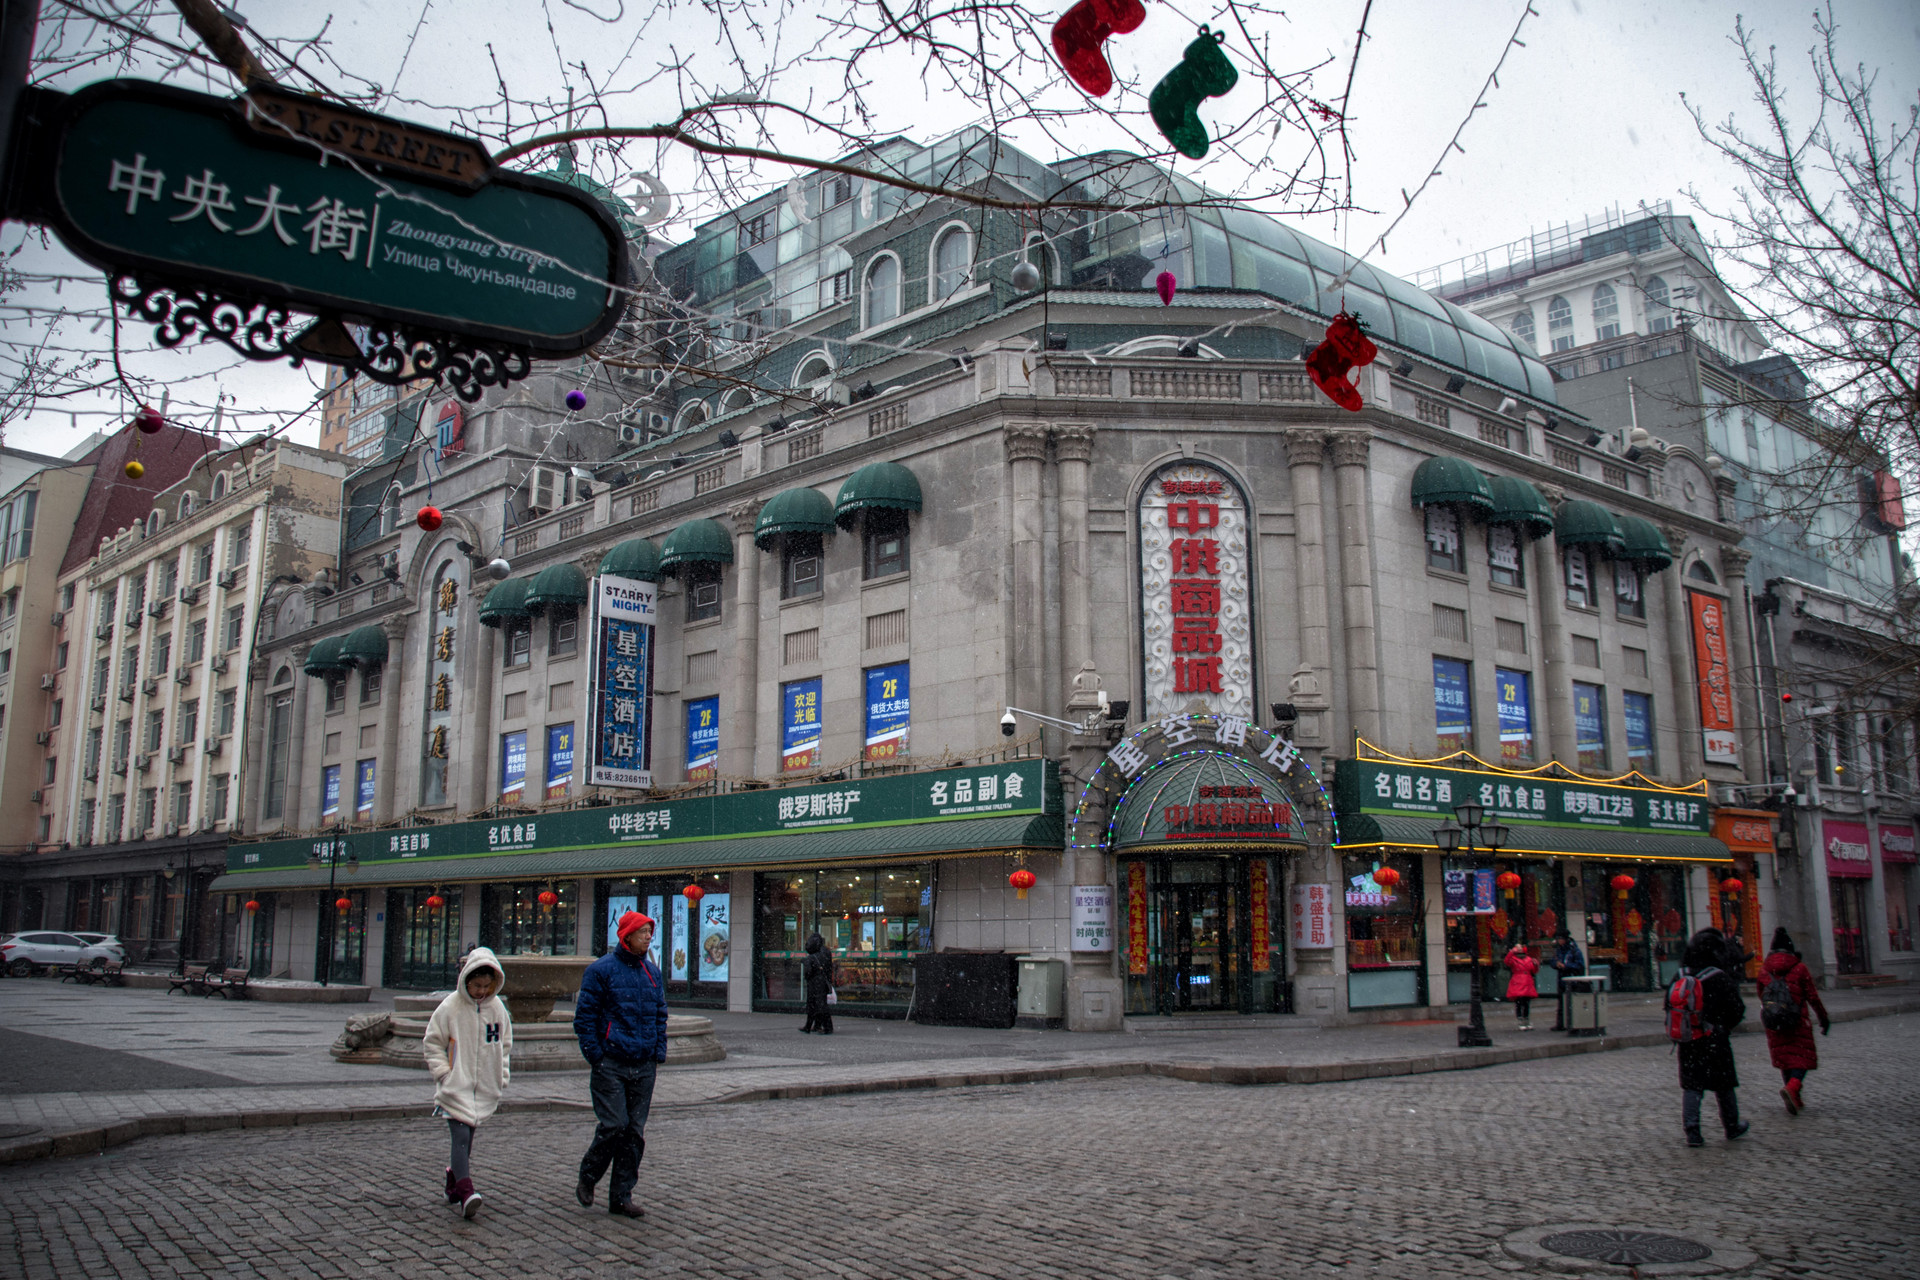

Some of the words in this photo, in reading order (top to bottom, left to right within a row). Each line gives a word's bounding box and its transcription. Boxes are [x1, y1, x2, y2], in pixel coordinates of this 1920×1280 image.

[107, 152, 368, 261] 中央大街
[387, 219, 494, 257] Zhongyang
[496, 244, 557, 270] Street
[384, 243, 440, 273] Улица
[446, 256, 576, 299] Чжунъяндацзе
[606, 586, 652, 603] STARRY
[1167, 499, 1224, 694] 中俄商品城
[612, 598, 648, 614] NIGHT
[612, 630, 638, 758] 星空酒店
[883, 679, 897, 699] 2F
[1434, 687, 1464, 706] 聚划算
[1504, 683, 1516, 702] 2F
[794, 691, 816, 708] 欢迎
[871, 698, 909, 715] 俄货大卖场
[1579, 697, 1589, 714] 2F
[700, 709, 712, 727] 2F
[794, 707, 816, 724] 光临
[559, 734, 569, 750] 2F
[692, 727, 719, 741] 俄罗斯食品
[1107, 712, 1300, 778] 星空酒店
[596, 771, 648, 784] 电话:82366111
[1375, 772, 1452, 803] 名烟名酒
[930, 772, 1024, 806] 名品副食
[1479, 782, 1546, 810] 名优食品
[778, 790, 860, 820] 俄罗斯特产
[1563, 790, 1634, 818] 俄罗斯工艺品
[1648, 798, 1700, 822] 东北特产
[608, 809, 671, 834] 中华老字号
[1164, 803, 1292, 827] 中俄商品城
[390, 833, 430, 852] 珠宝首饰
[488, 823, 537, 844] 名优食品
[1075, 896, 1111, 906] 星空酒店
[705, 904, 728, 925] 灵芝
[1309, 886, 1325, 944] 韩盛自助
[1076, 928, 1112, 937] 时尚餐饮
[486, 1023, 499, 1043] H
